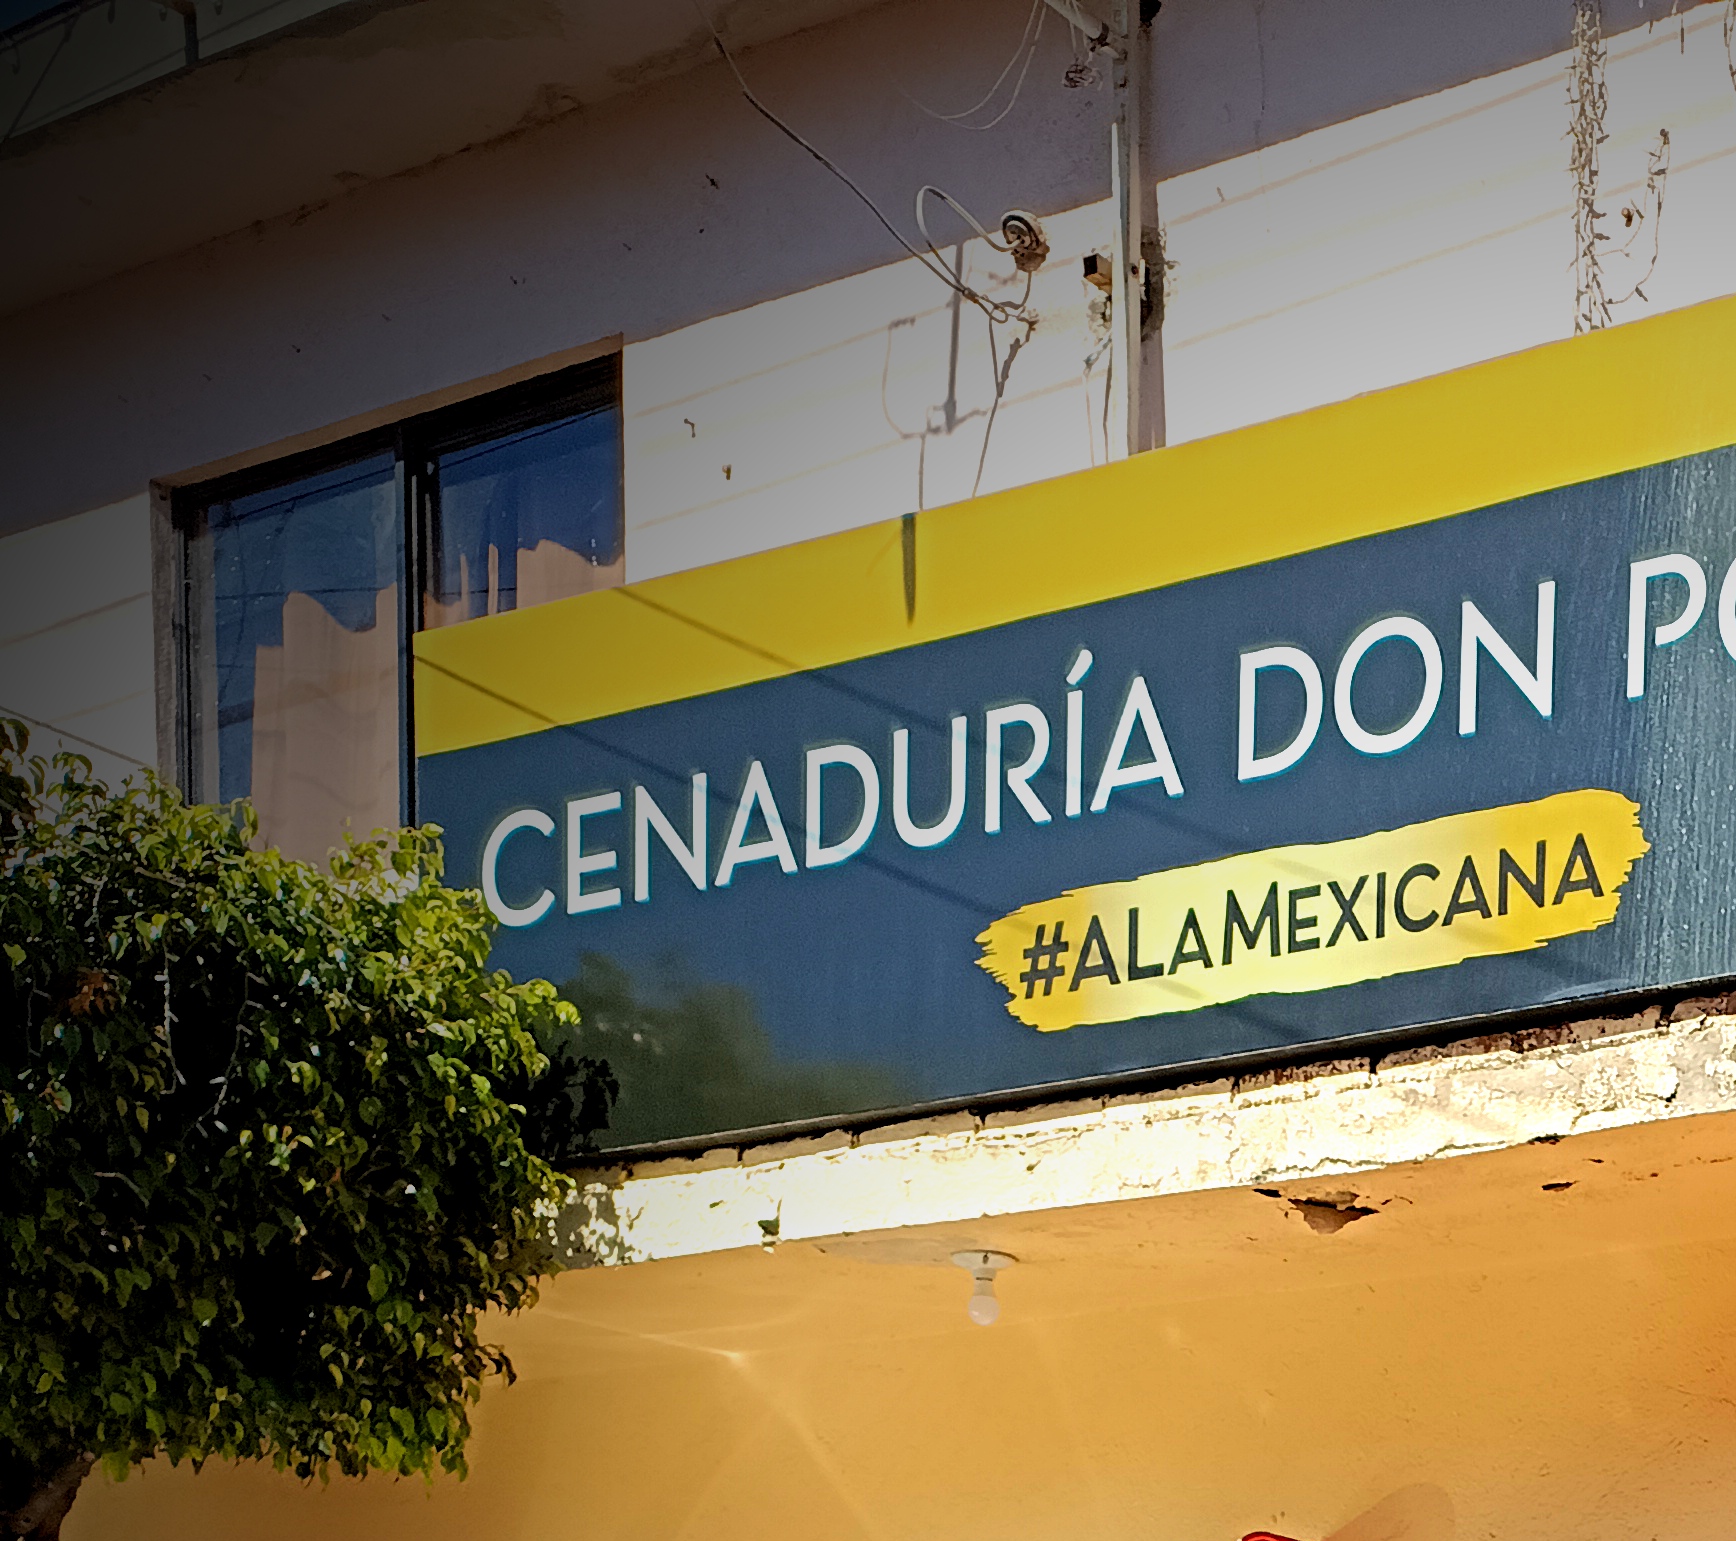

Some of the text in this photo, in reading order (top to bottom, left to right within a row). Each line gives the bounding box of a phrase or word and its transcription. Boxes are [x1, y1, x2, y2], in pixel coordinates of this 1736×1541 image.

[479, 648, 1185, 928] CENADURÍA
[1237, 581, 1559, 784] DON
[1019, 831, 1607, 1001] #ALAMEXICANA
